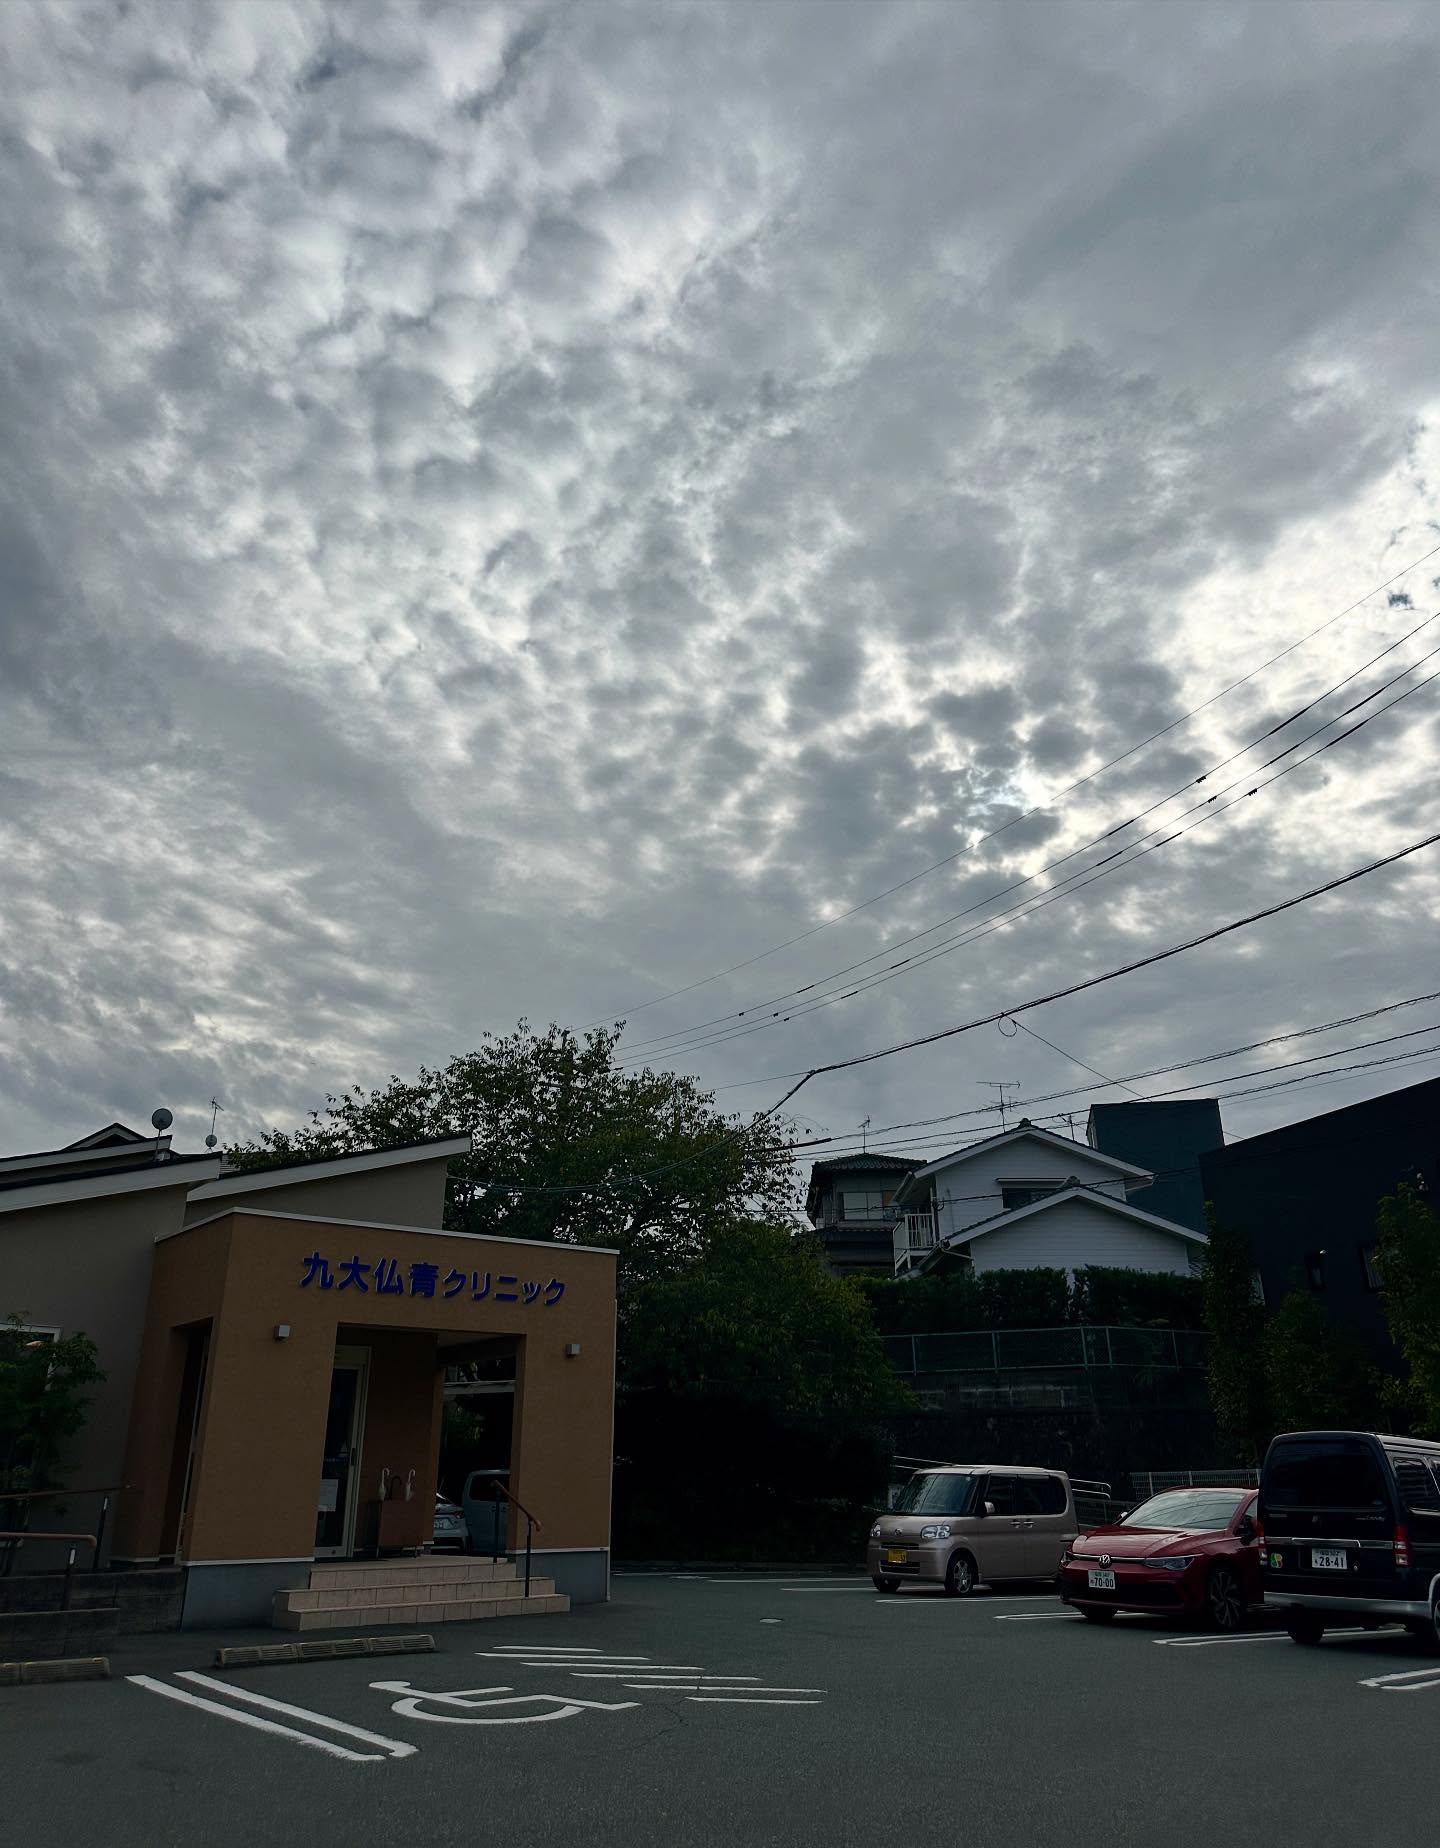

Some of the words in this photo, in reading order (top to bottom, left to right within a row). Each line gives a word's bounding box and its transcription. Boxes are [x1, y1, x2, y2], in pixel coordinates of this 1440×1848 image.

[299, 1251, 566, 1306] 九大仏青クリニック
